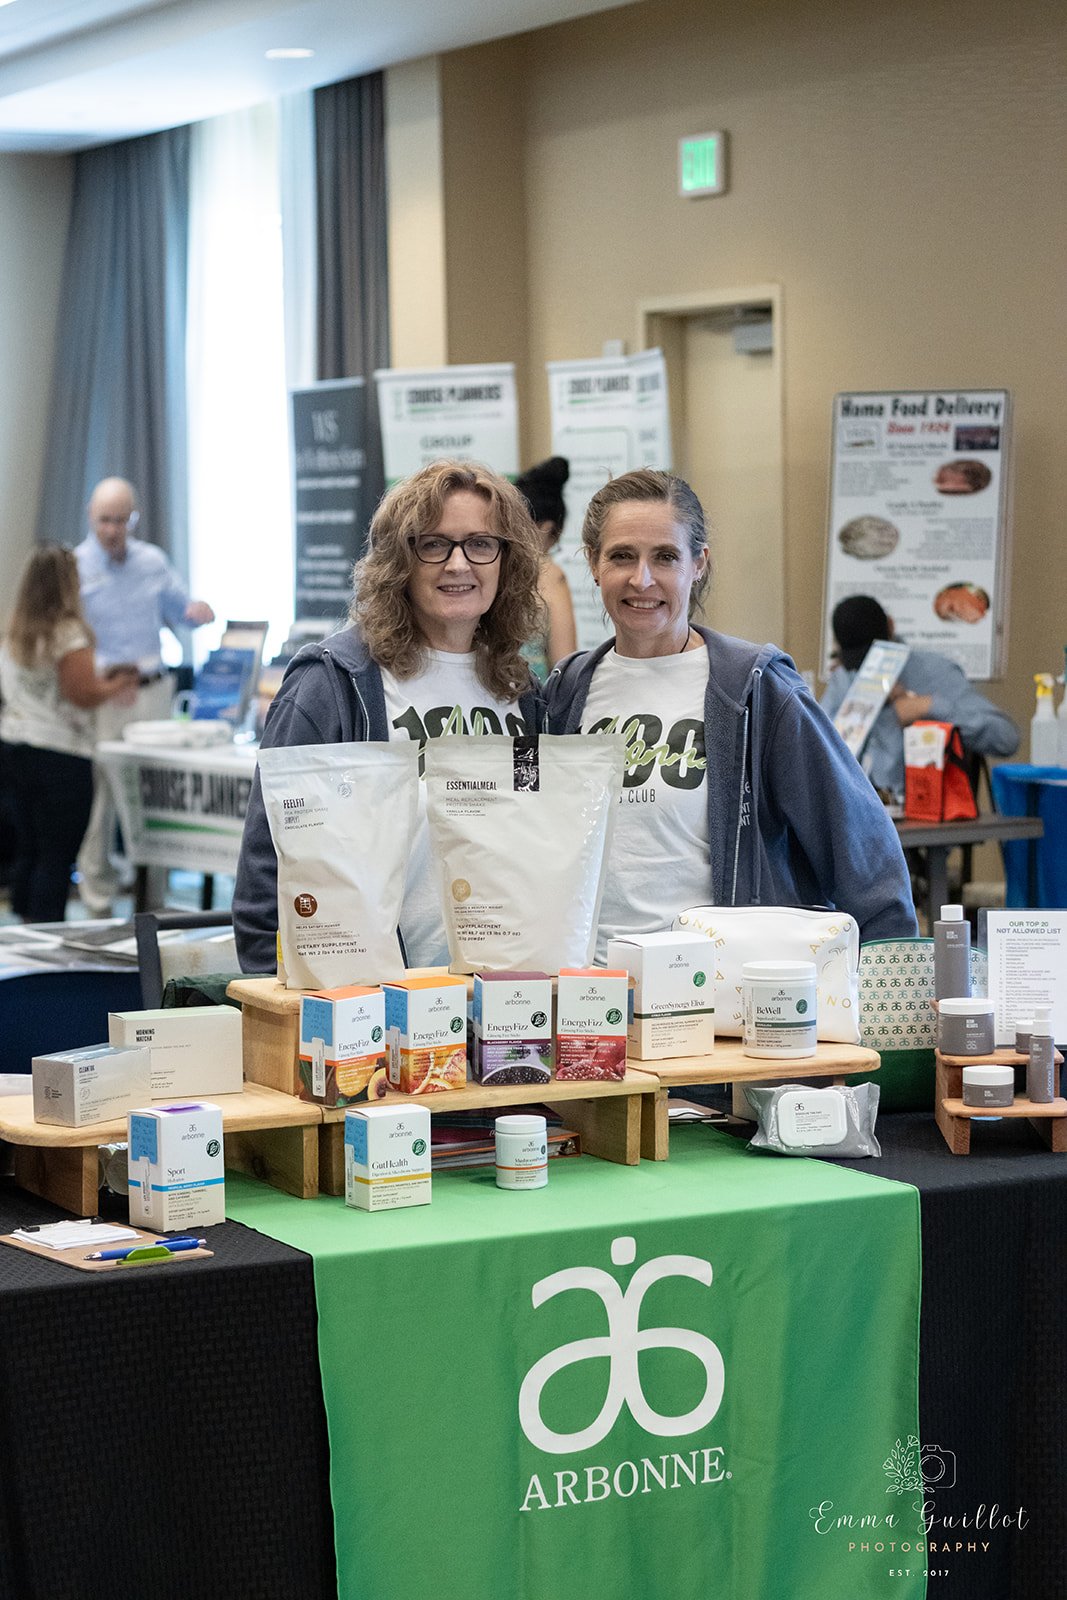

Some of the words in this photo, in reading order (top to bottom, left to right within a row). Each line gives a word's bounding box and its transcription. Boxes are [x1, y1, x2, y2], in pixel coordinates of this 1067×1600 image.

[891, 398, 928, 416] Food
[935, 397, 1000, 419] Delivery
[446, 781, 497, 790] ESSENTIALMEAL
[628, 789, 656, 803] CLUB
[283, 798, 304, 809] FEELFIT
[428, 1005, 450, 1013] arbonne
[651, 1000, 690, 1010] GreenSynergy
[691, 999, 705, 1007] Elixir
[756, 1006, 781, 1014] BeWell
[351, 1014, 371, 1023] arbonne
[561, 1018, 603, 1028] EnergyFizz
[136, 1028, 155, 1036] MORNING
[487, 1023, 529, 1033] EnergyFizz
[413, 1030, 449, 1041] EnergyFizz
[338, 1040, 370, 1052] EnergyFizz
[181, 1132, 206, 1140] arbonne
[388, 1130, 412, 1138] arbonne
[371, 1158, 409, 1170] GutHealth
[167, 1168, 186, 1177] Sport
